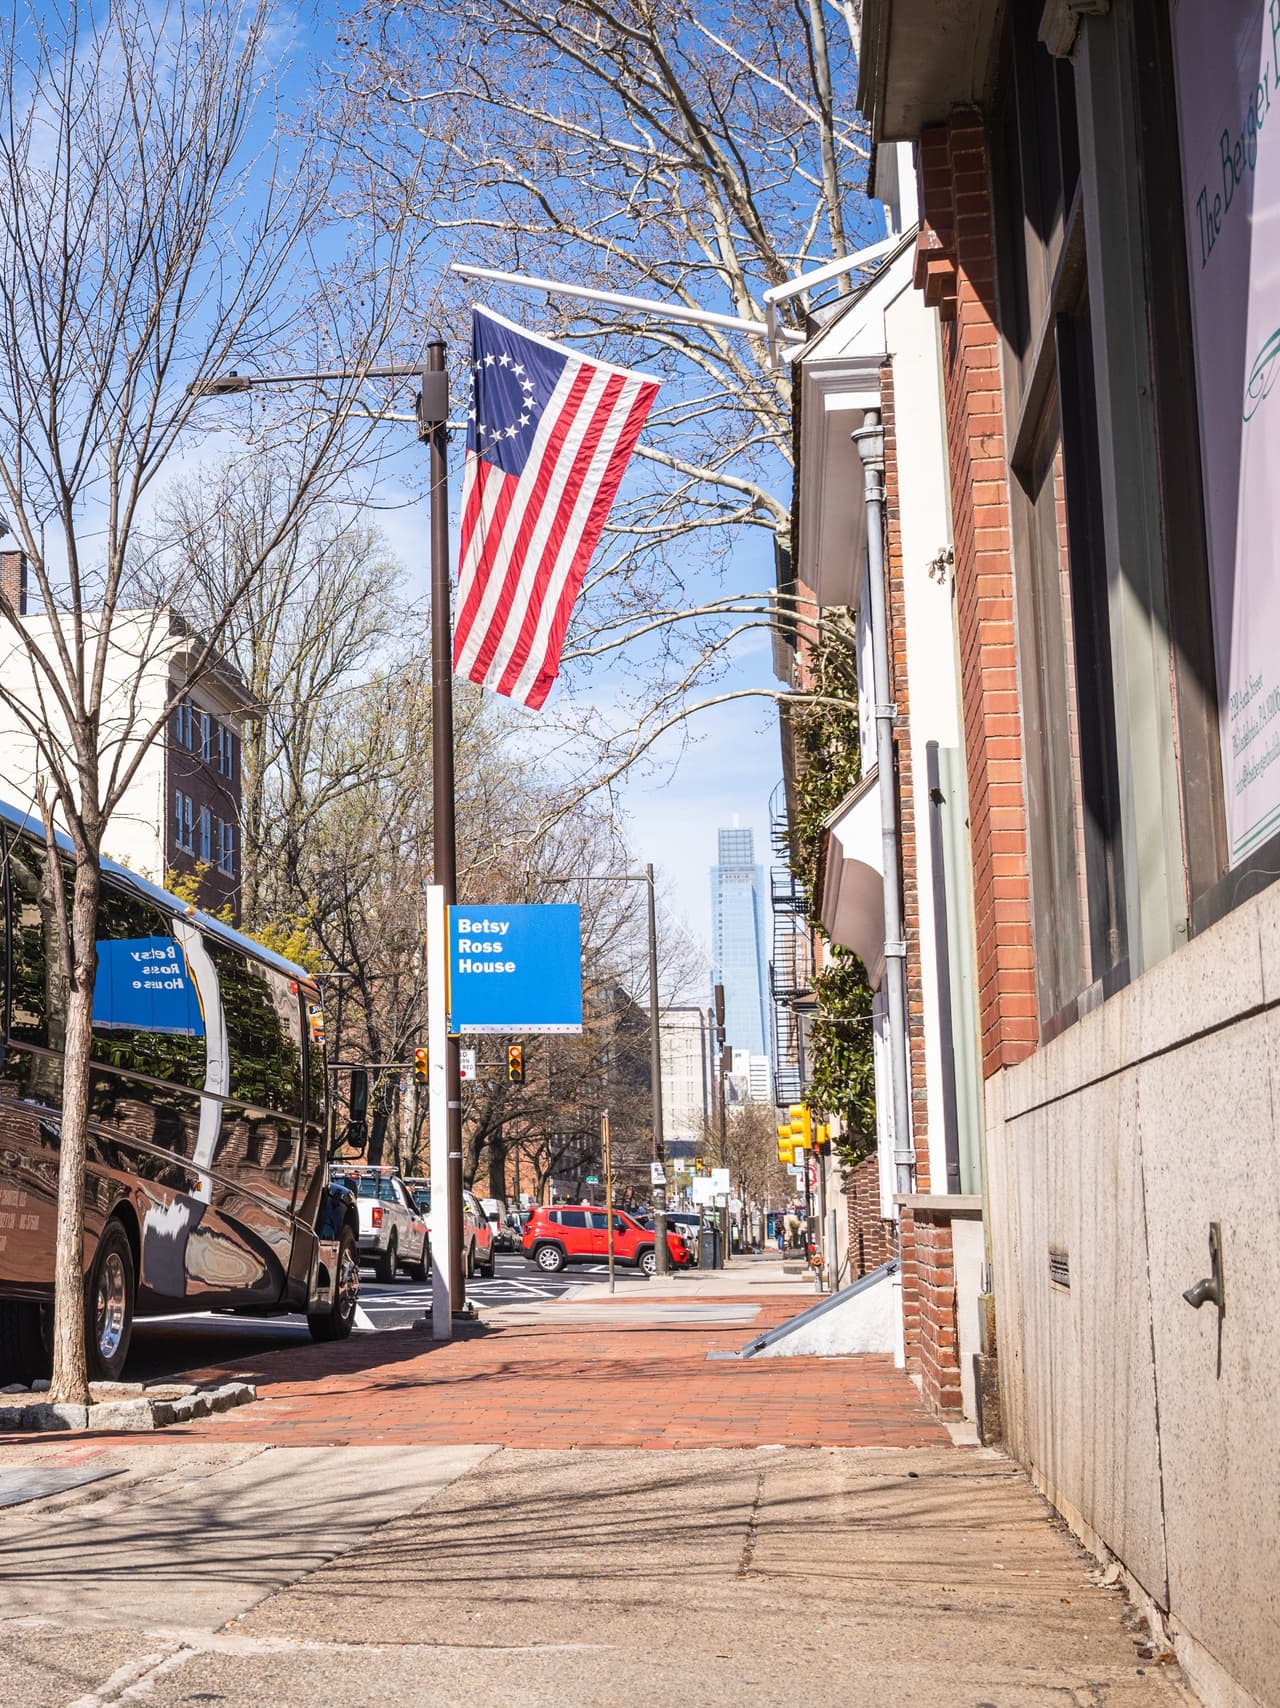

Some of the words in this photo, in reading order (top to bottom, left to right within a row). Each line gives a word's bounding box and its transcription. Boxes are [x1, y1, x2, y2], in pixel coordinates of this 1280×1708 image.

[1196, 184, 1221, 270] The
[1220, 61, 1271, 215] Berger
[458, 918, 510, 936] Betsy
[458, 938, 503, 953] Ross
[458, 958, 516, 973] House
